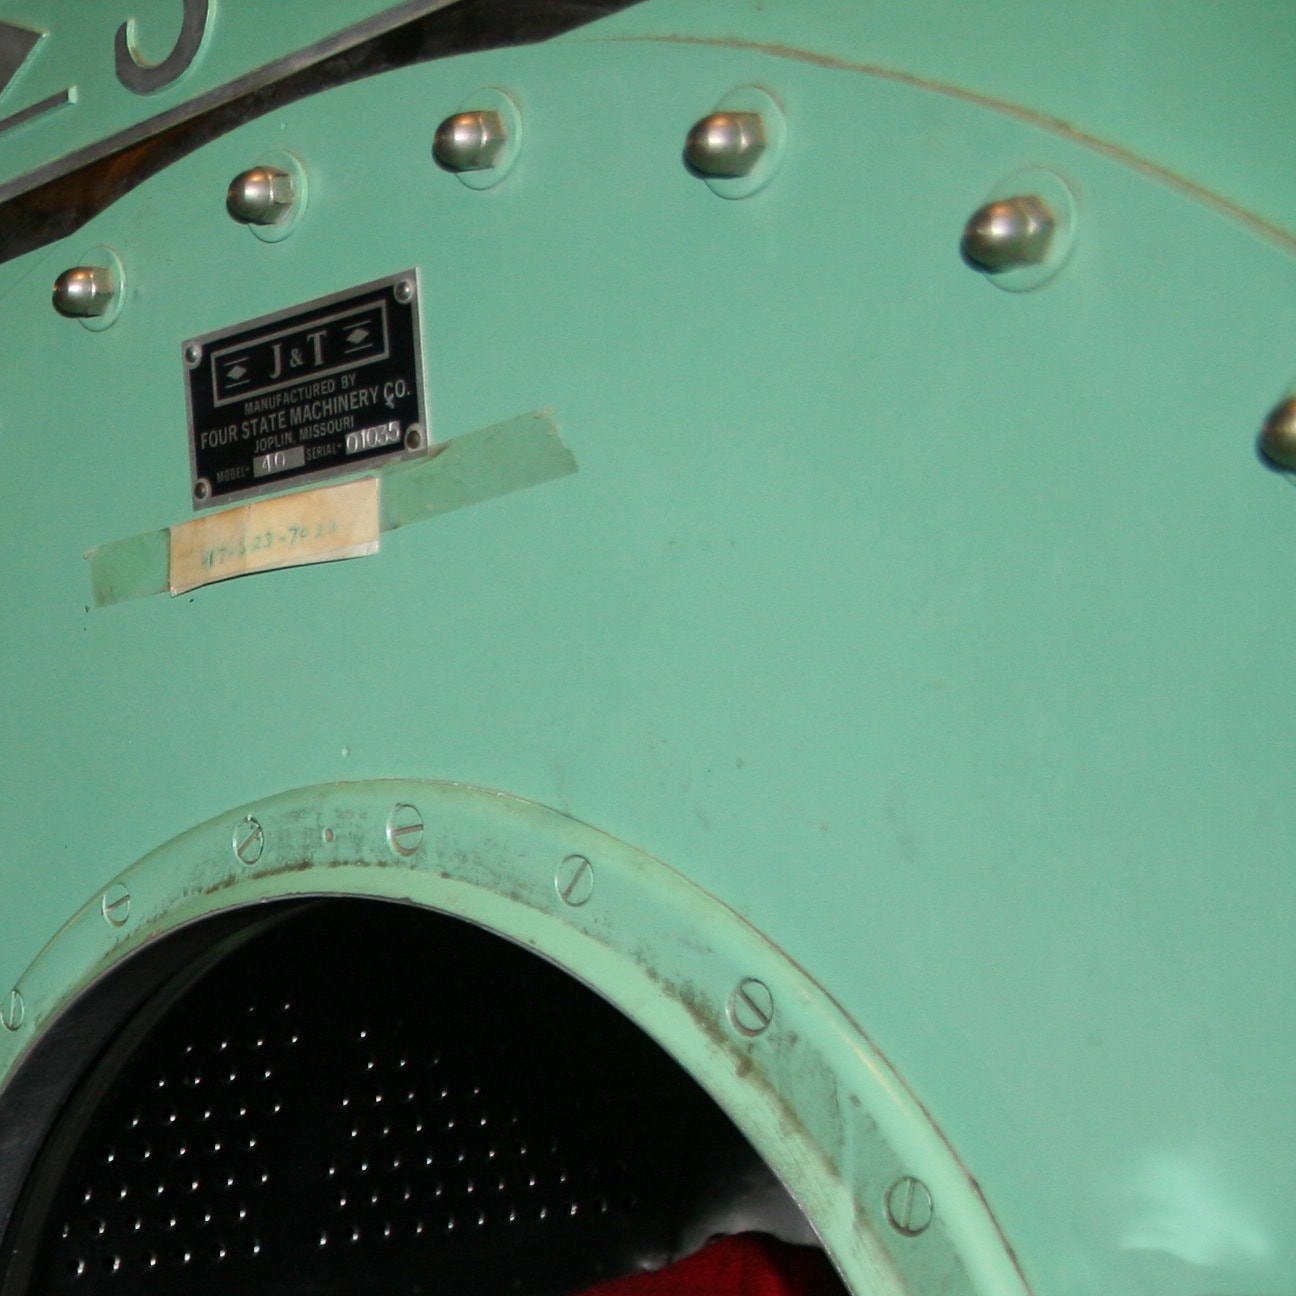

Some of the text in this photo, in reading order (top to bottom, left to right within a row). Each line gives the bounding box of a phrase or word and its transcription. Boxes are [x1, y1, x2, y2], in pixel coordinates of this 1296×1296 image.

[244, 372, 357, 416] MANUFACTURED BY
[201, 424, 238, 450] FOUR
[241, 410, 287, 440] STATE
[289, 385, 379, 426] MACHINERY
[299, 415, 355, 441] MISSOURI
